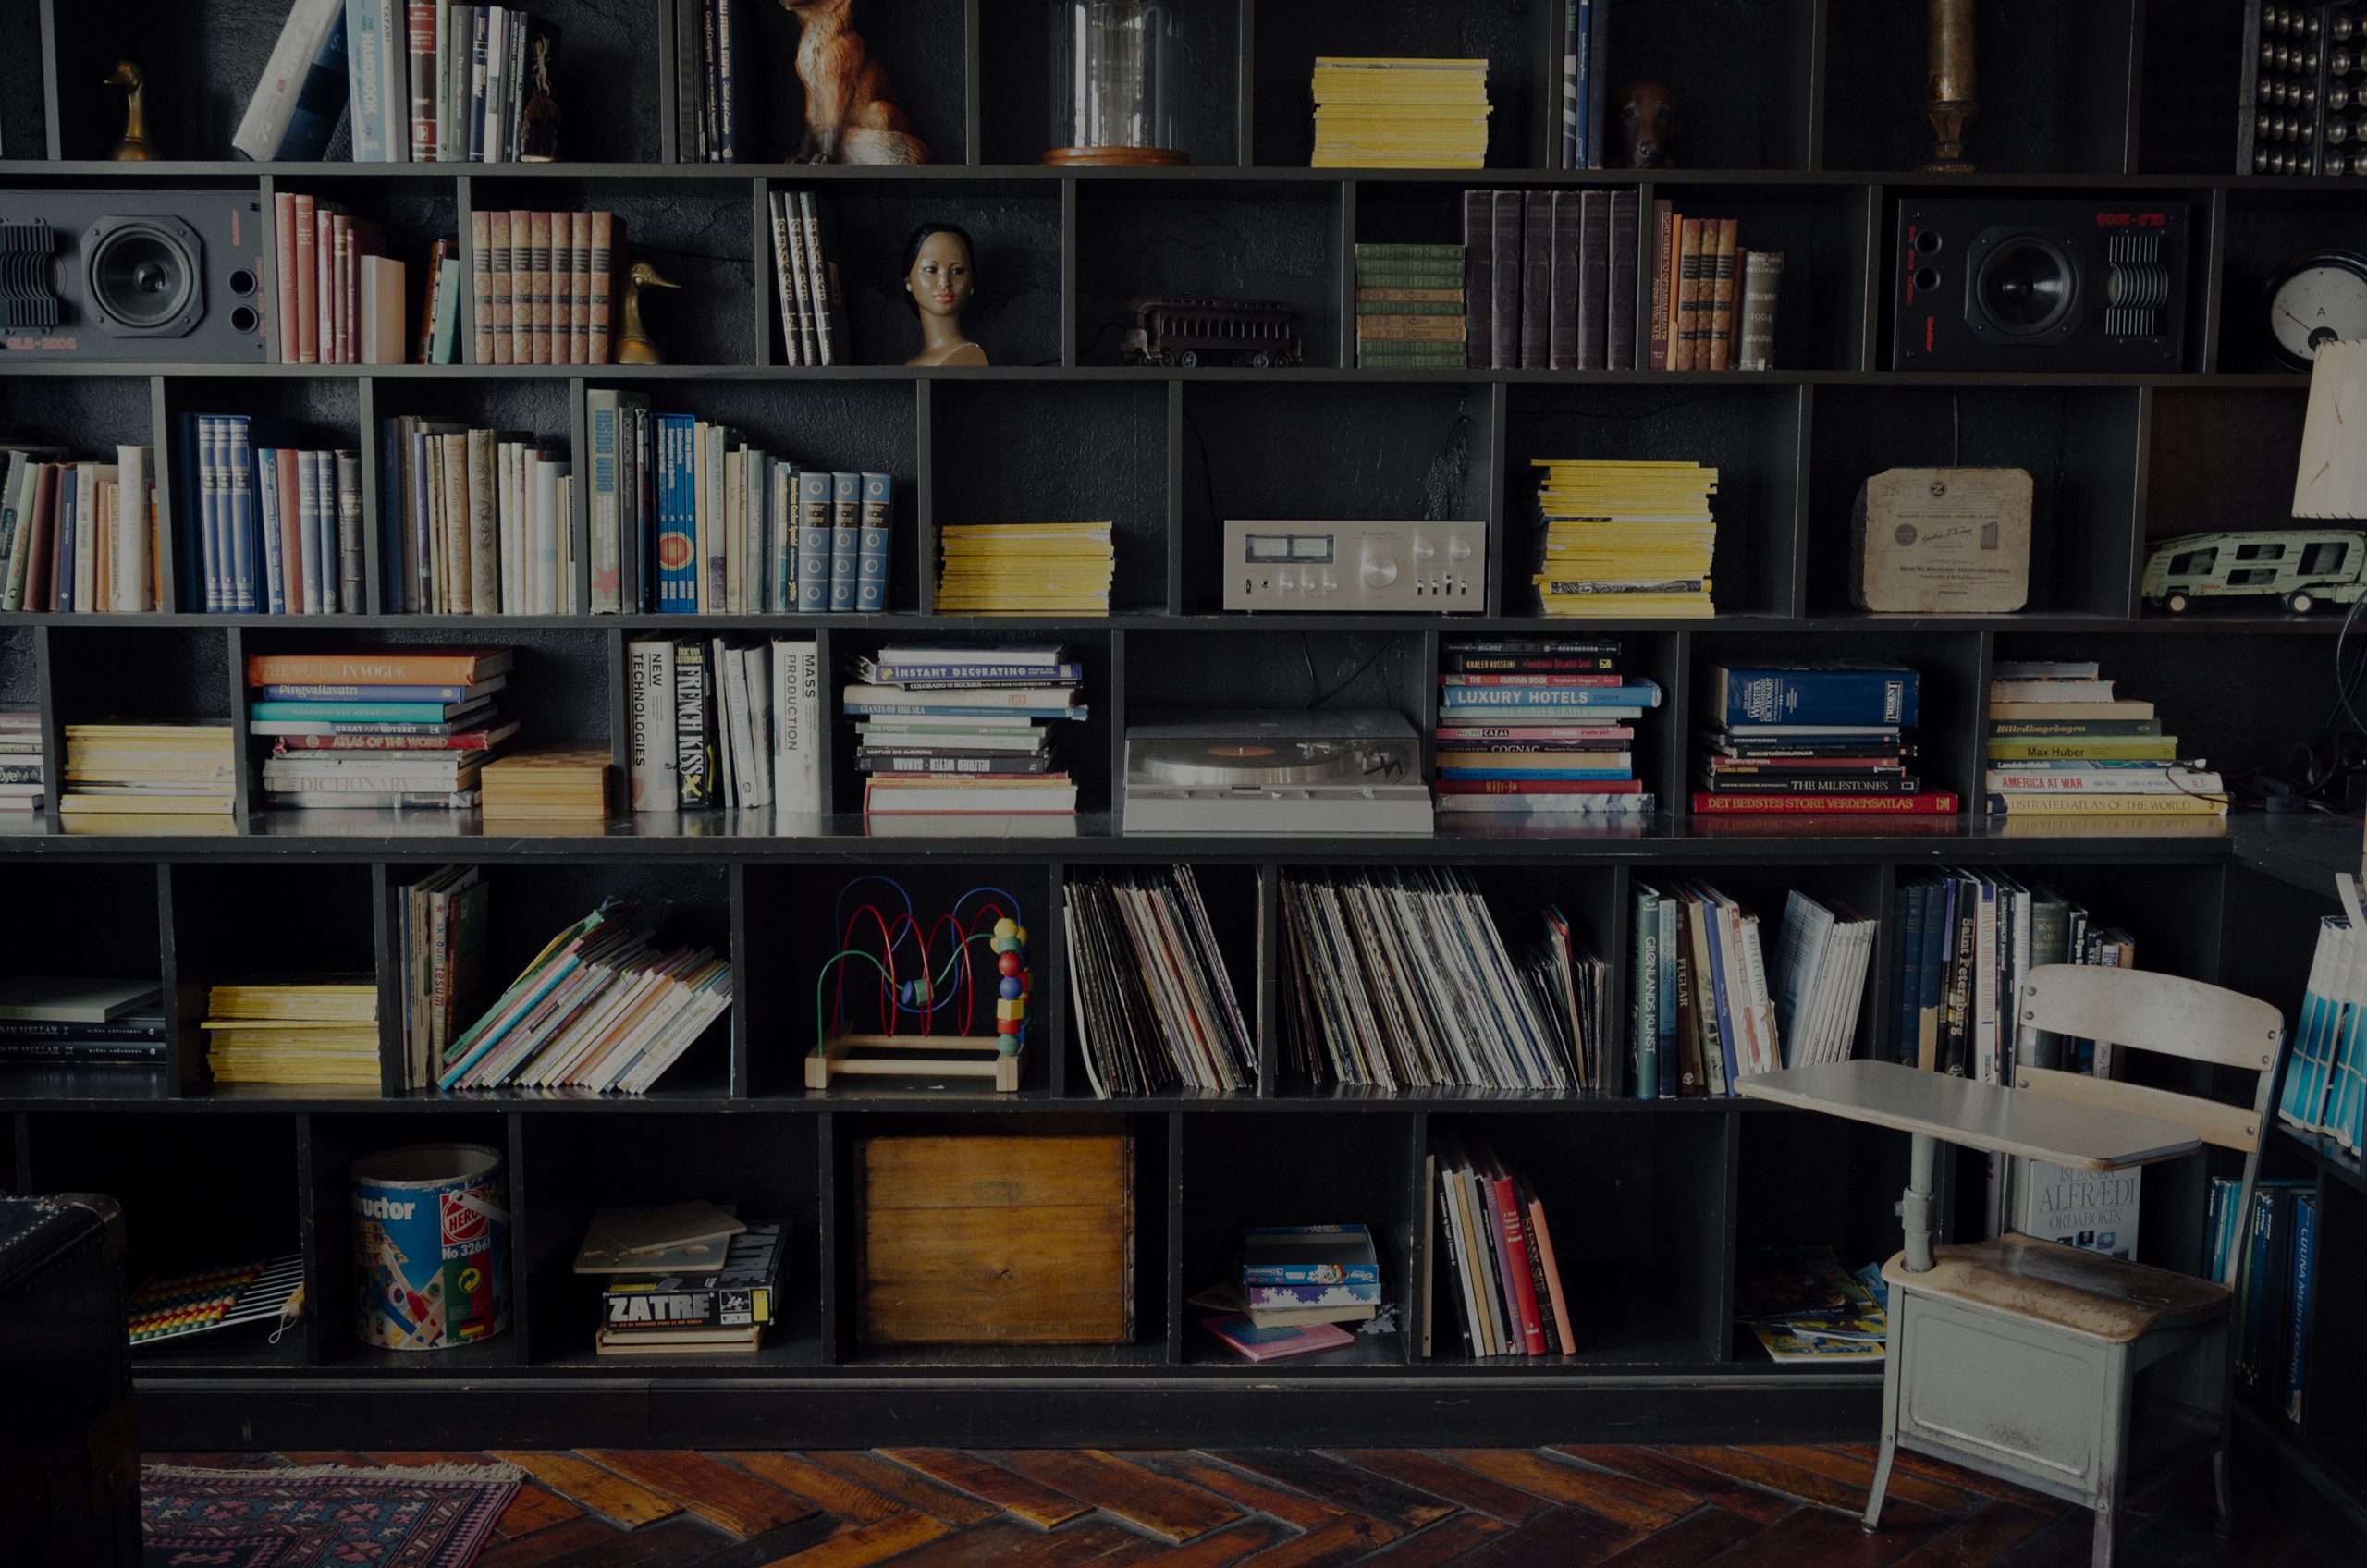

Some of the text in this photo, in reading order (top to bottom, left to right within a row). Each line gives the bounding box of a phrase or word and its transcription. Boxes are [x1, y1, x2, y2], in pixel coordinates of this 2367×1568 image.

[705, 11, 714, 31] Good
[705, 31, 716, 63] Company
[361, 33, 379, 115] HANDBOOK
[1662, 211, 1671, 234] EIGHT
[1662, 261, 1670, 272] TO
[1661, 272, 1669, 311] OPTIMUM
[1749, 312, 1772, 324] 1904
[2316, 307, 2326, 316] A
[1660, 311, 1668, 341] HEALTH
[622, 416, 632, 463] POSSESSIONS
[790, 477, 799, 505] American
[264, 664, 292, 678] THE
[341, 664, 357, 678] IN
[360, 664, 406, 678] VOGUE
[652, 653, 663, 687] NEW
[894, 666, 947, 678] INSTANT
[952, 666, 1027, 679] DECORATING
[1466, 660, 1489, 668] KHALED
[1489, 660, 1515, 668] HOSSEINI
[804, 654, 816, 699] MASS
[1469, 676, 1482, 684] THE
[1482, 676, 1500, 684] NEW
[1500, 676, 1528, 685] CURTAIN
[1528, 676, 1548, 685] BOOK
[787, 654, 798, 751] PRODUCTION
[1457, 690, 1621, 704] LUXURY HOTELS EUROPE
[1749, 680, 1761, 718] WEBSTER'S
[1764, 677, 1774, 722] DICTIONARY
[1885, 682, 1899, 721] TRIDENT
[633, 653, 645, 767] TECHNOLOGIES
[861, 705, 926, 715] GIANTS OF THE SEA
[335, 725, 418, 734] GREAT APE ODYSSEY
[676, 665, 705, 776] FRENCH KISS
[1996, 724, 2087, 734] Billedkogebogen
[332, 734, 448, 748] ATLAS OF THE WORLD
[1482, 729, 1510, 738] CAZAL
[1490, 745, 1540, 753] COGNAC
[2027, 747, 2085, 757] Max Huber
[892, 757, 924, 771] SAHARA
[929, 758, 956, 771] WEYER
[300, 777, 410, 793] DICTIONARY
[1790, 780, 1889, 791] THE MILESTONES
[2002, 777, 2045, 790] AMERICA
[2047, 777, 2060, 790] AT
[2061, 777, 2084, 790] WAR
[1708, 797, 1914, 811] DET BEDSTES STORE VERDENSATLAS
[2010, 800, 2191, 812] USTRATED ATLAS OF THE WORLD
[1748, 933, 1765, 1006] REFLECTIONS
[1949, 916, 1974, 1036] Saint Petersburg
[435, 966, 446, 1007] lesum
[1677, 957, 1689, 1008] FUGLAR
[1644, 935, 1657, 1055] GRØNLANDS KUNST
[442, 1247, 460, 1261] No
[608, 1293, 711, 1323] ZATRE
[2289, 1227, 2310, 1385] CULINA MEDITERRANEA
